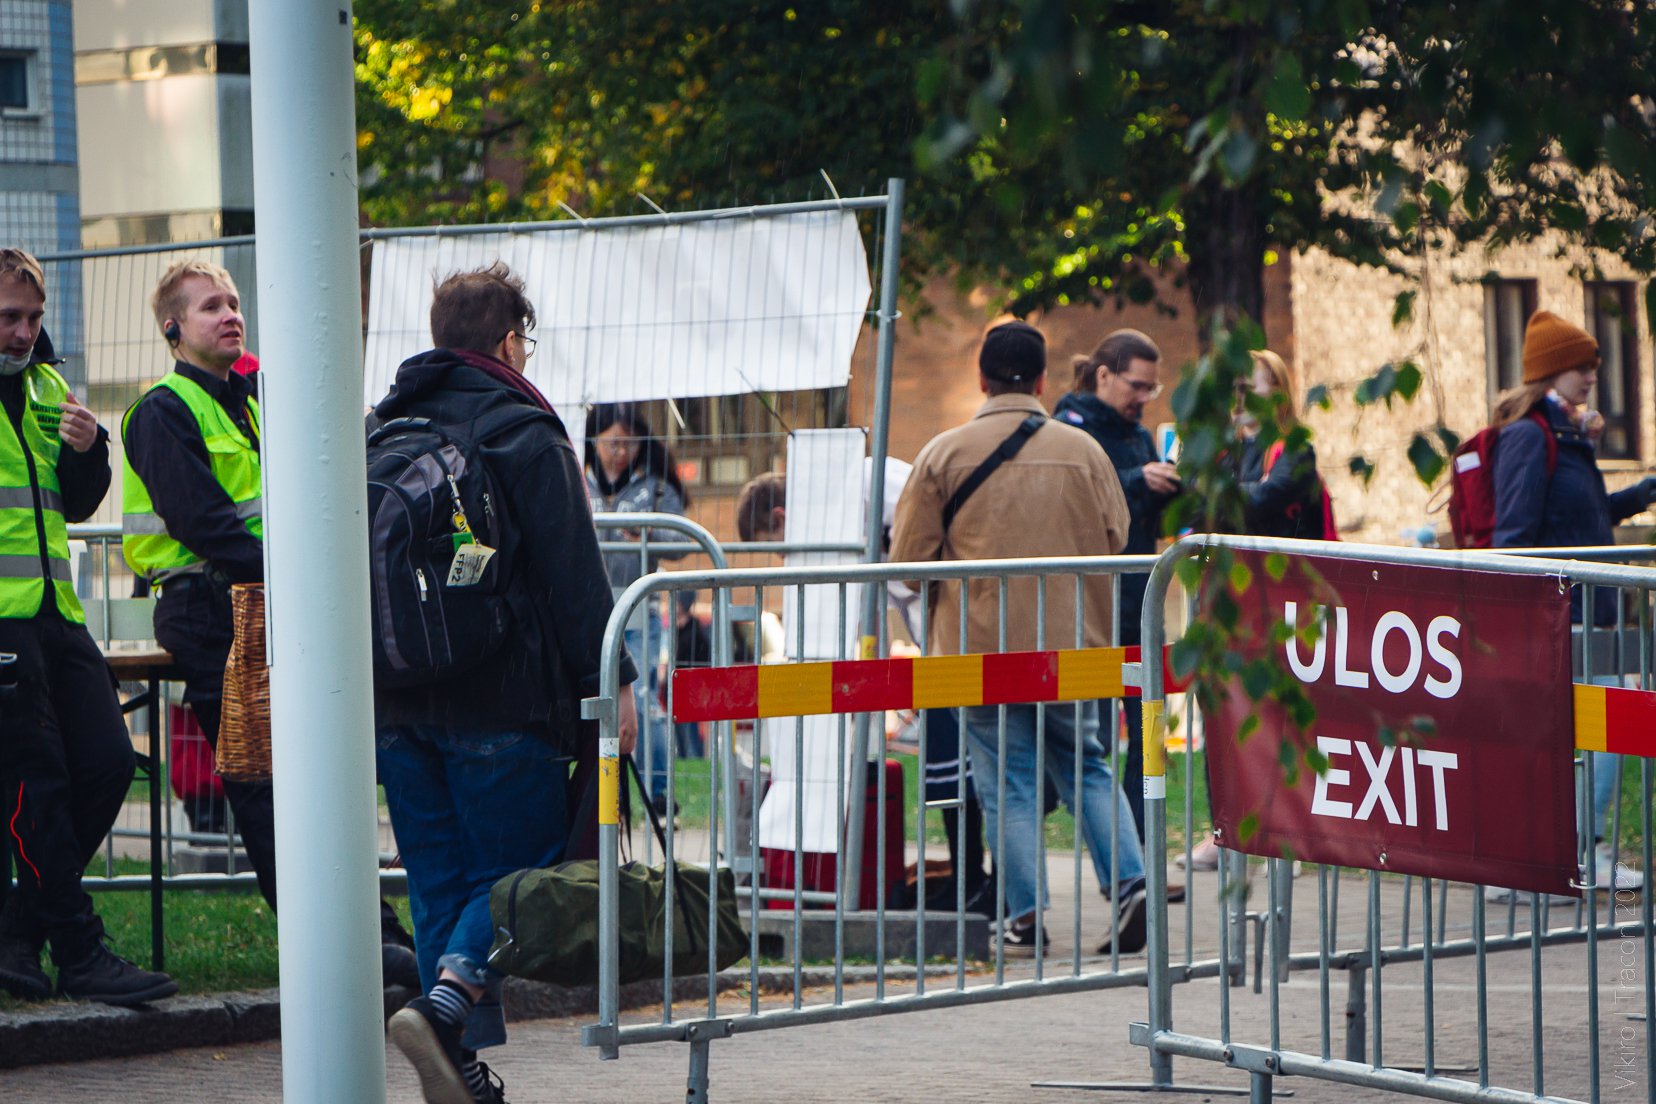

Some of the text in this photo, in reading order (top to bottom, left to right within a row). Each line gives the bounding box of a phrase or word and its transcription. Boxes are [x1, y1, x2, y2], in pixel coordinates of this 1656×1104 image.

[452, 553, 466, 582] FFP2
[1285, 601, 1463, 699] ULOS
[1311, 735, 1458, 831] EXIT
